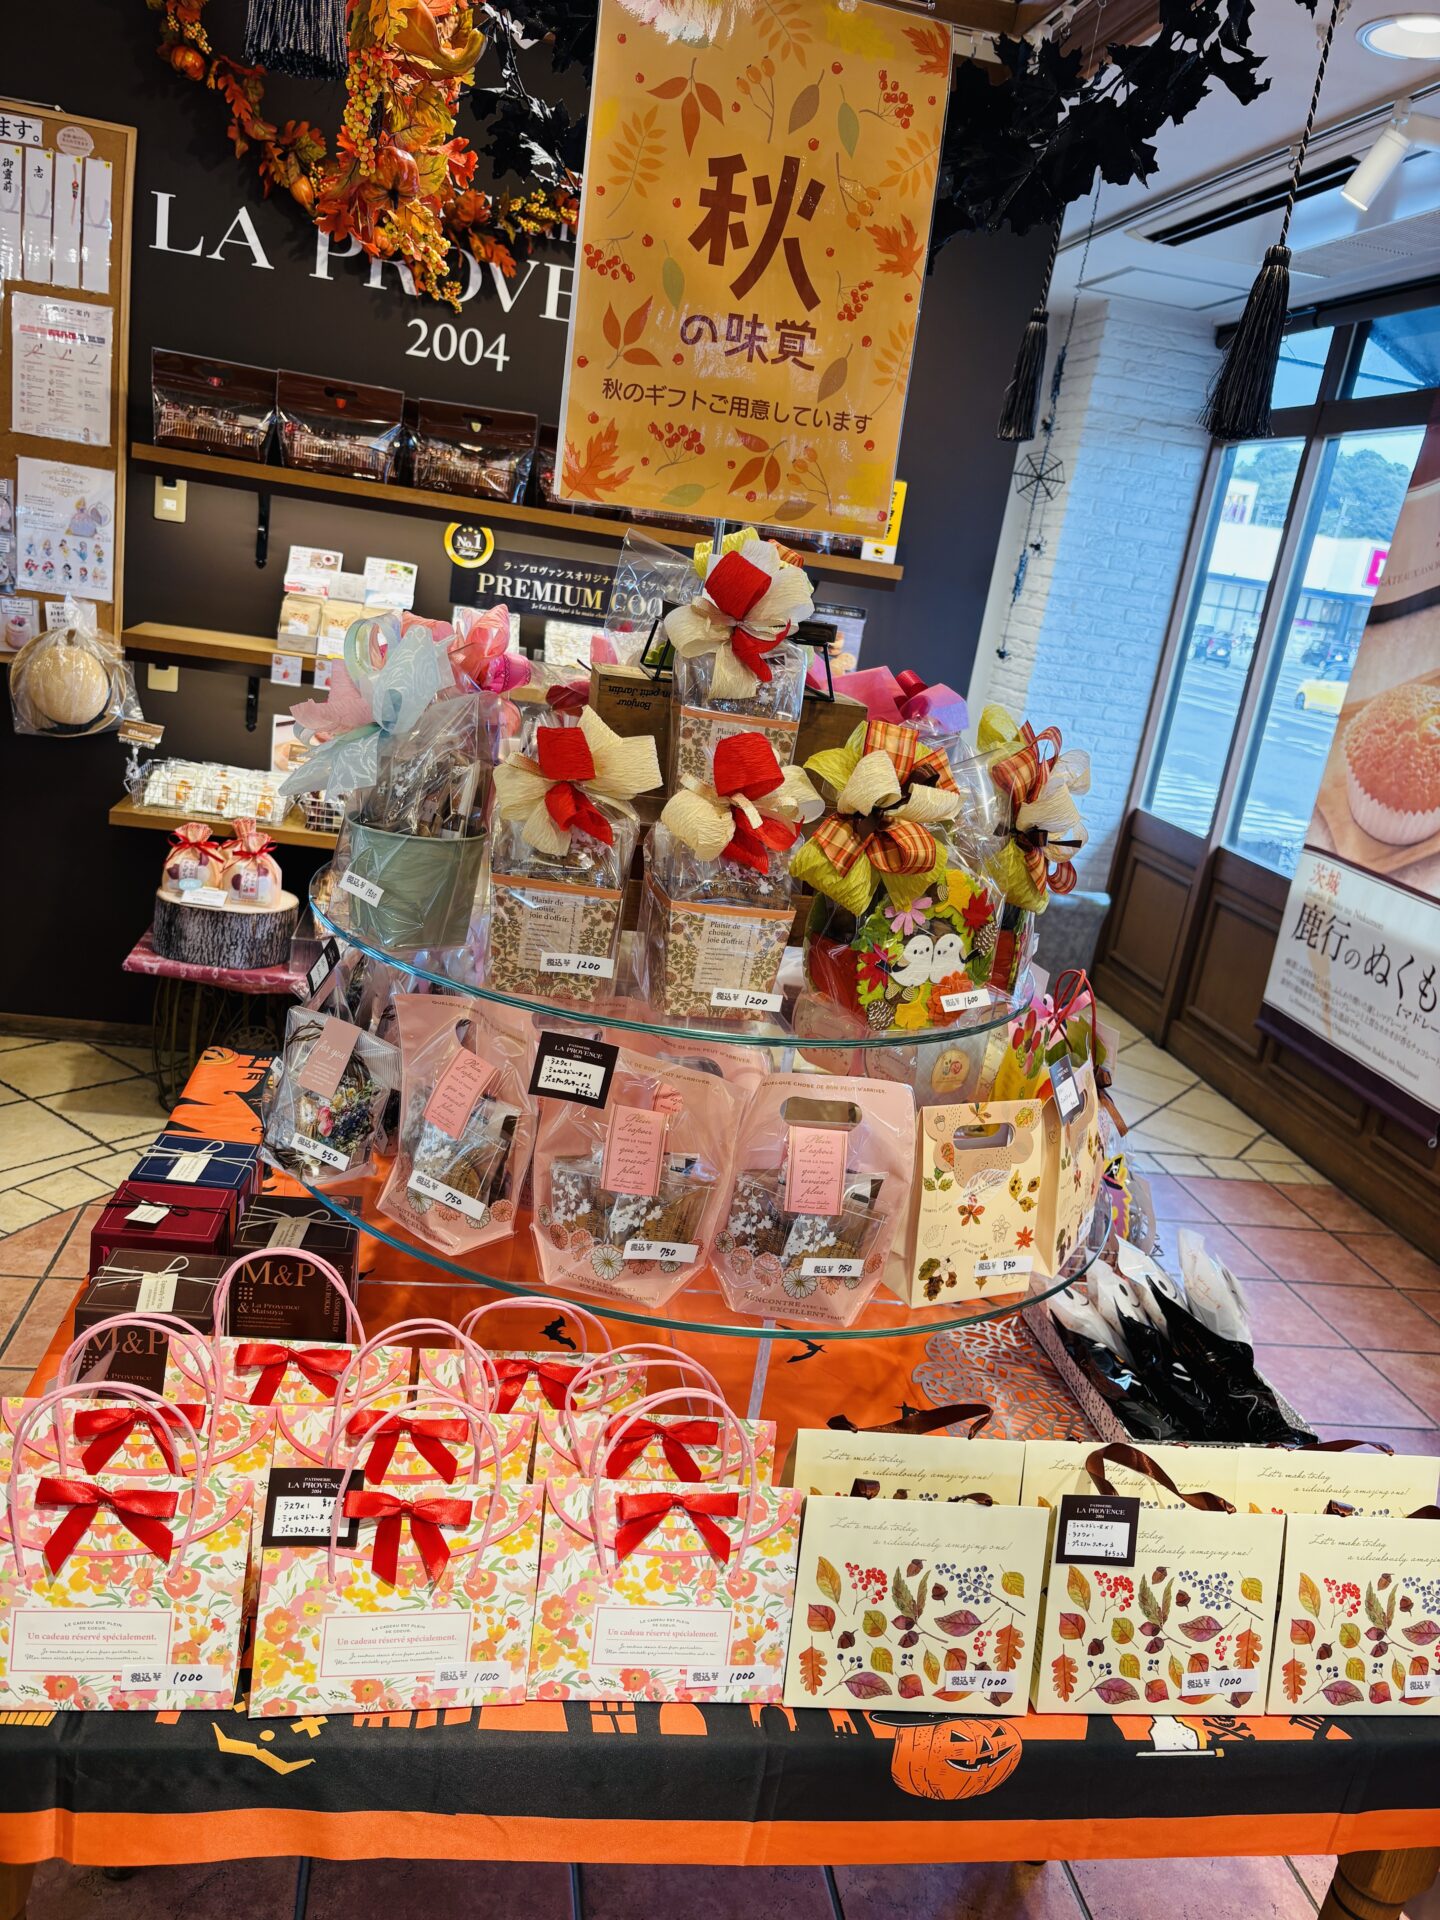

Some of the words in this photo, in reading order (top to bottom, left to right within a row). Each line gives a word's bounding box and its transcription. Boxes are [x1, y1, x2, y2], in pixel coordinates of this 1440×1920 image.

[33, 166, 44, 179] 志
[149, 190, 275, 270] LA
[688, 153, 826, 311] 秋
[405, 318, 511, 372] 2004
[680, 313, 818, 372] の味覚
[601, 378, 873, 434] 秋のギフトご用意しています
[456, 534, 482, 550] No.1
[476, 572, 605, 611] PREMIUM
[1308, 862, 1341, 897] 茨城
[531, 895, 553, 905] Plaisir
[529, 912, 542, 920] joie
[710, 921, 730, 929] Plaisir
[1292, 902, 1437, 1014] 鹿行のぬくも
[577, 960, 600, 971] 1200
[745, 995, 768, 1006] 1200
[964, 995, 979, 1008] 1600
[566, 1048, 603, 1060] PROVENCE
[321, 1150, 339, 1162] 550
[444, 1191, 463, 1206] 750
[659, 1247, 677, 1257] 750
[239, 1261, 316, 1287] M&P
[837, 1264, 853, 1273] 750
[252, 1308, 284, 1316] Matsuya
[769, 1305, 826, 1318] EXCELLENT
[27, 1632, 40, 1640] Un
[41, 1632, 70, 1640] cadeau
[72, 1632, 101, 1640] réservé
[102, 1632, 157, 1642] spécialement.
[608, 1628, 619, 1636] Un
[620, 1628, 644, 1636] cadeau
[646, 1629, 671, 1637] réservé
[672, 1630, 719, 1639] spécialement.
[337, 1637, 348, 1646] Un
[350, 1636, 376, 1645] cadeau
[378, 1635, 405, 1644] réservé
[406, 1634, 457, 1644] spécialement.
[172, 1671, 204, 1684] 1000
[473, 1673, 500, 1683] 1000
[729, 1672, 756, 1684] 1000
[981, 1676, 1008, 1690] 1000
[1219, 1676, 1243, 1688] 1000
